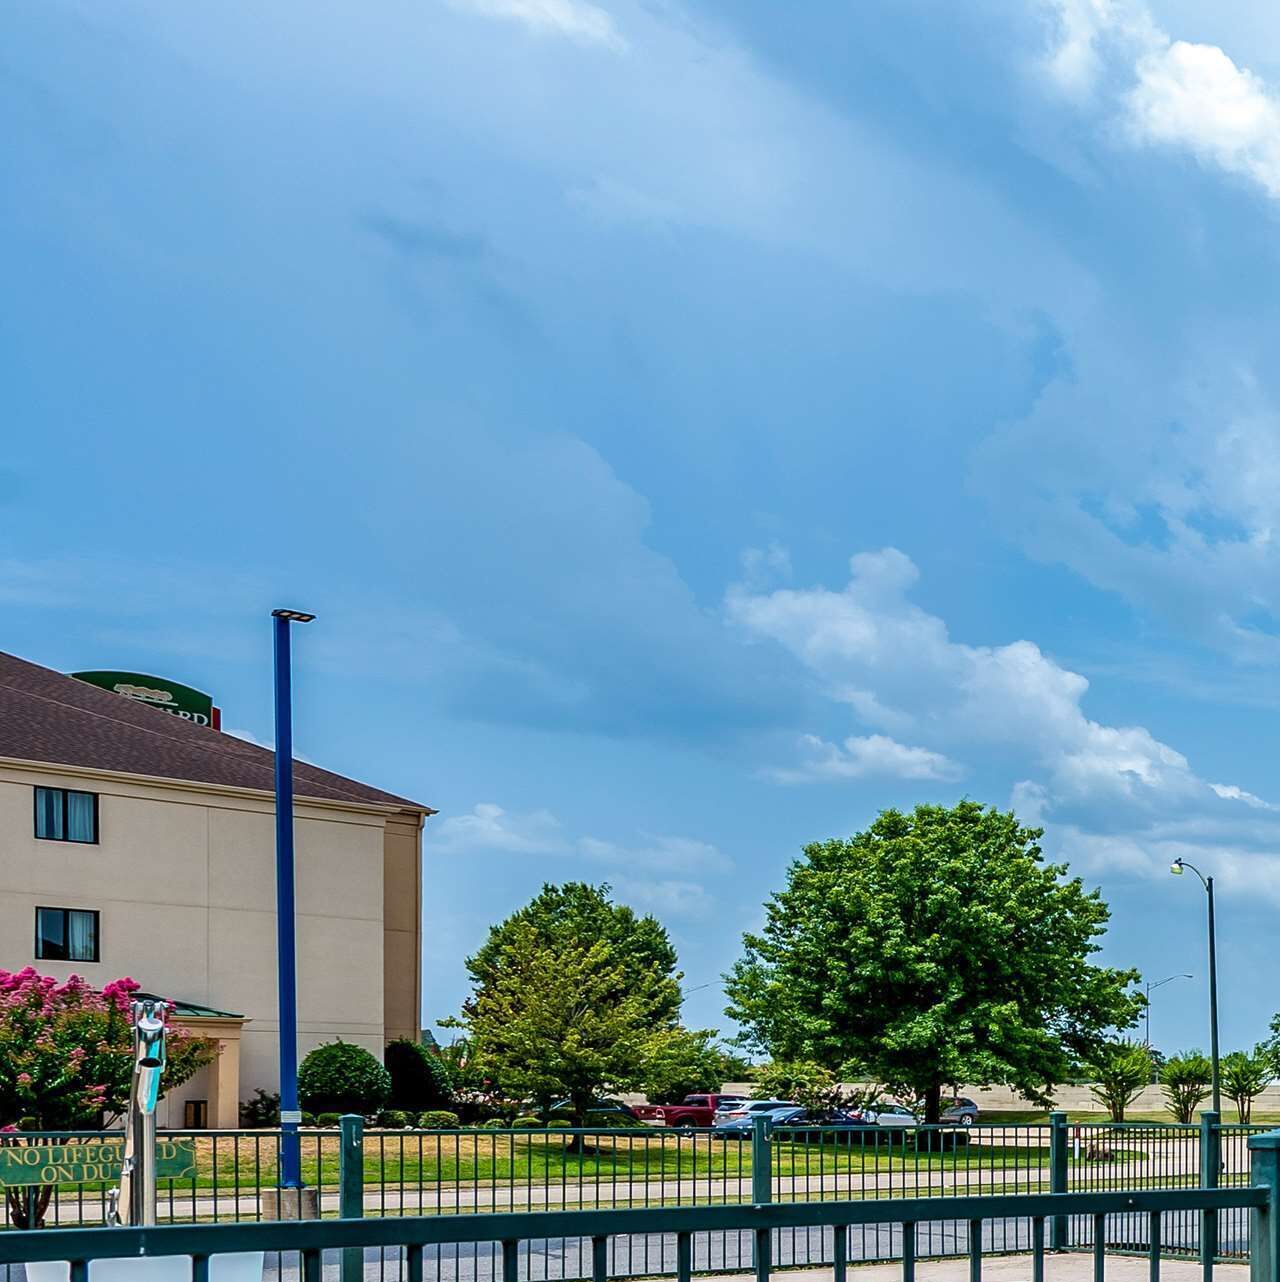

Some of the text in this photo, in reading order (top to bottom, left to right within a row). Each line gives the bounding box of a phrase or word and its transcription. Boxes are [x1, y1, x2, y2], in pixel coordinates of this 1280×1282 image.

[7, 1143, 177, 1166] NO LIFEGUD
[41, 1162, 123, 1183] ON DU
